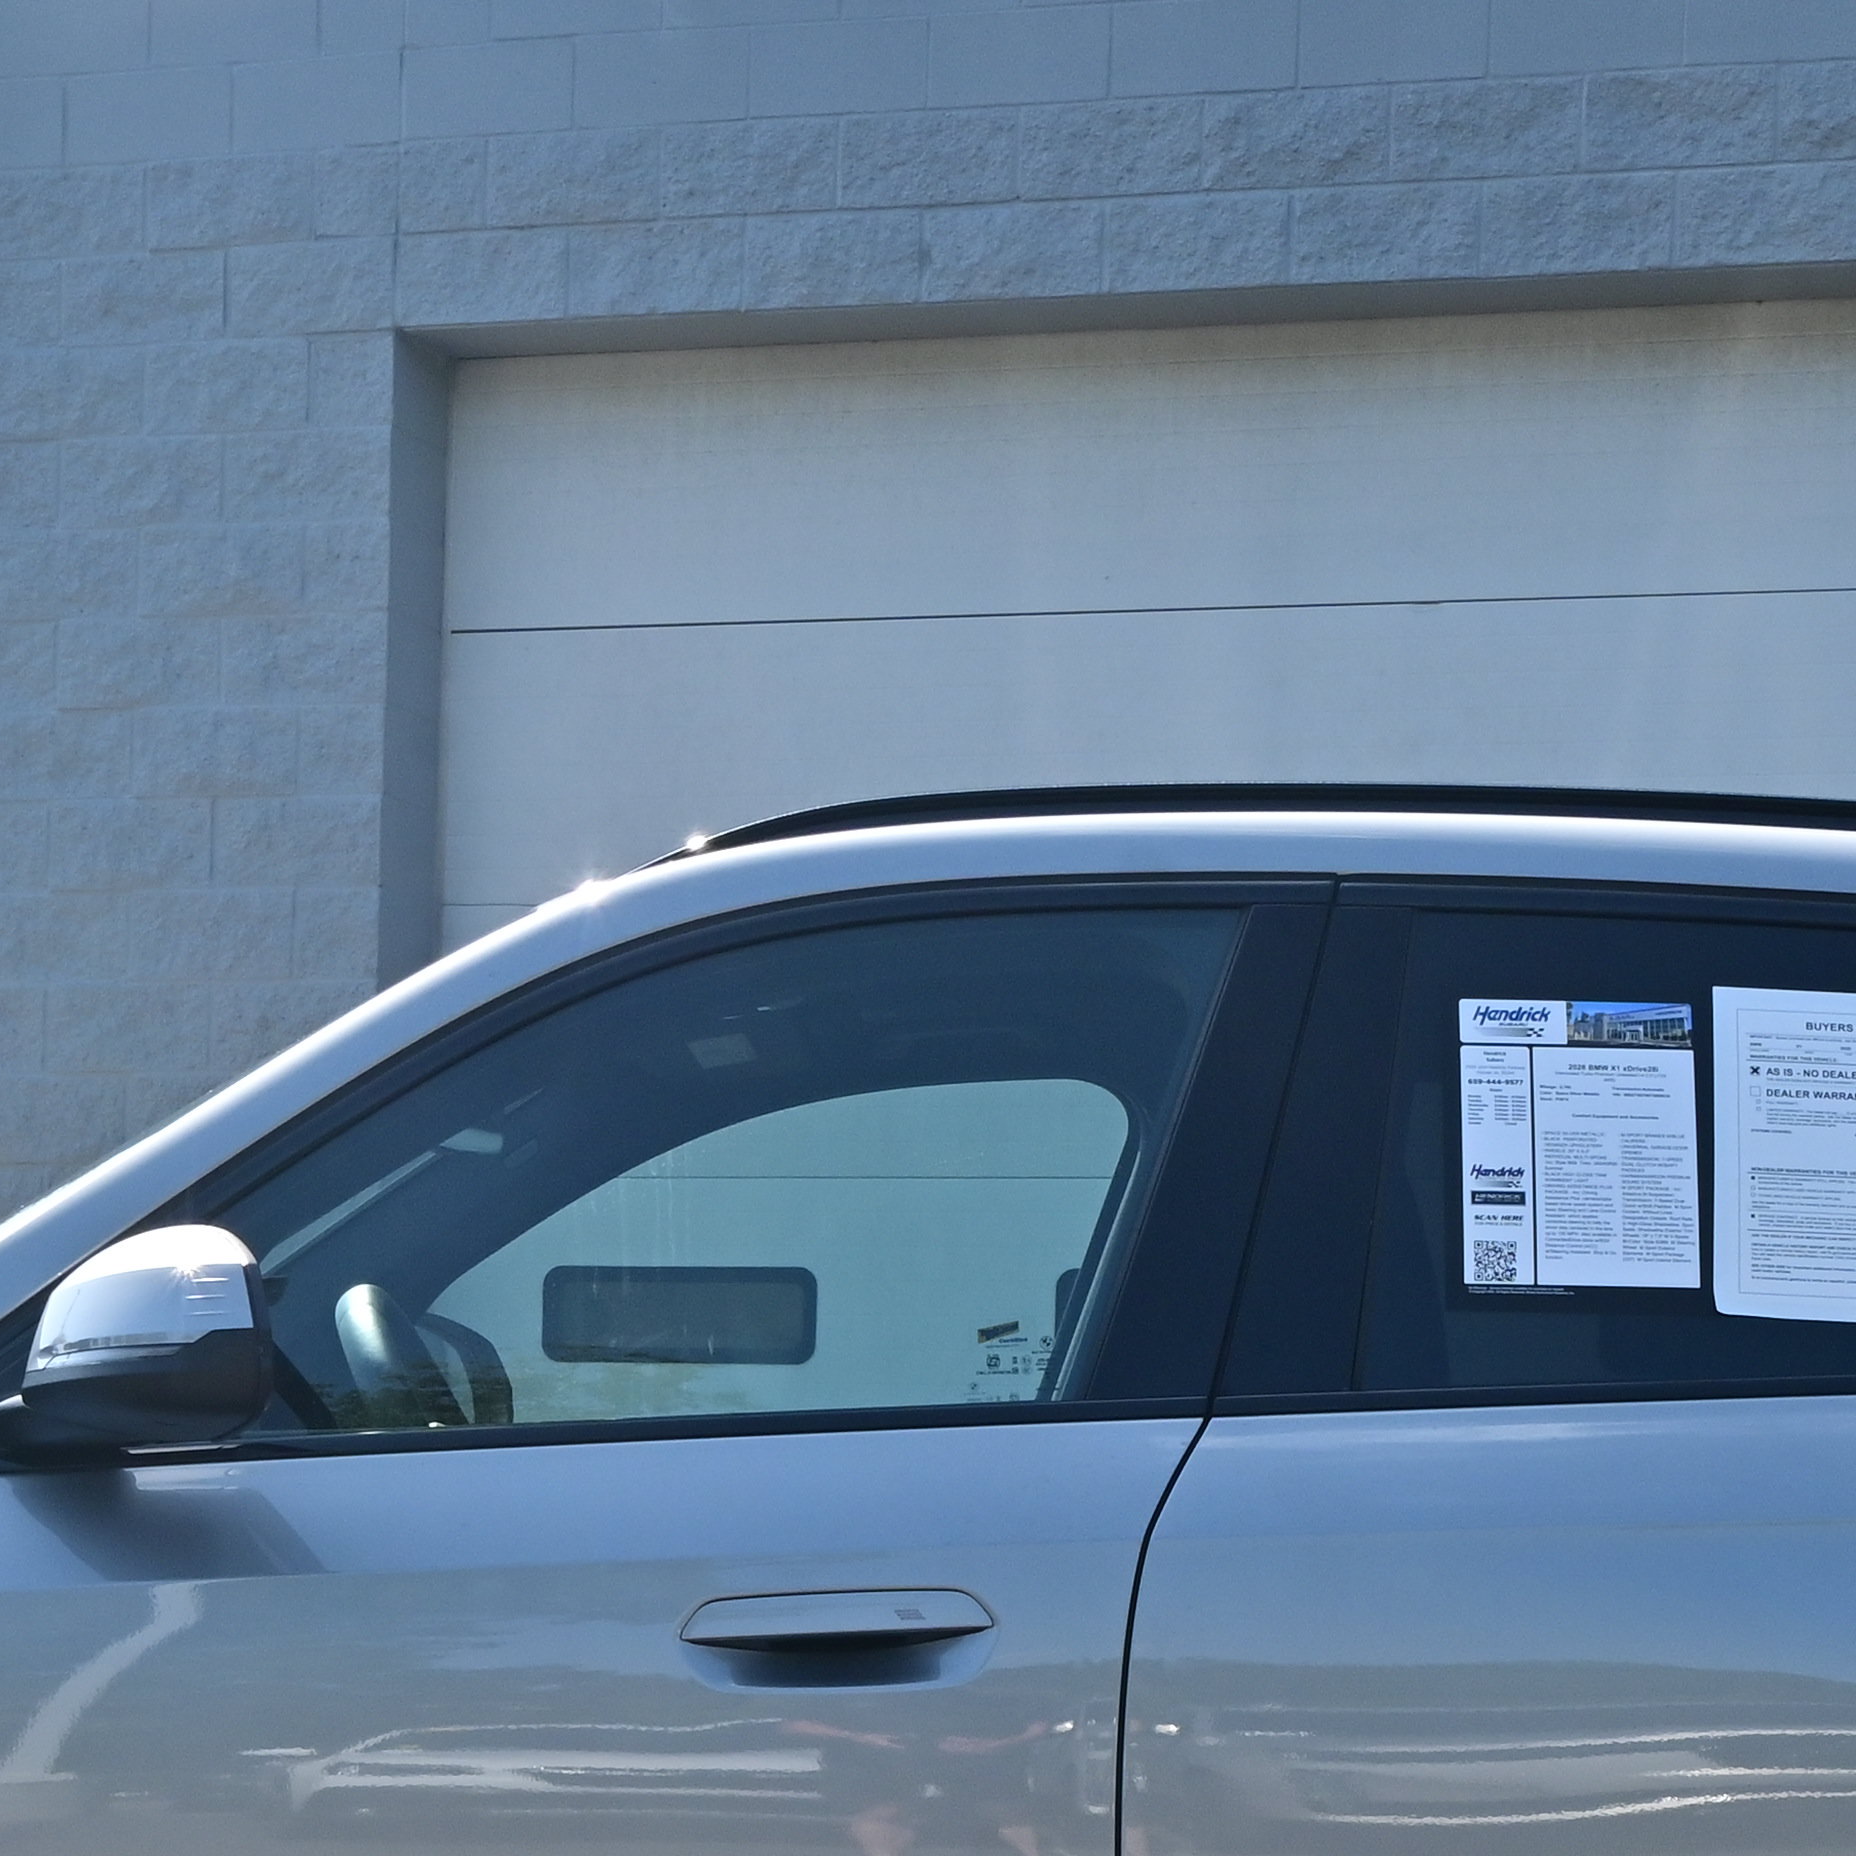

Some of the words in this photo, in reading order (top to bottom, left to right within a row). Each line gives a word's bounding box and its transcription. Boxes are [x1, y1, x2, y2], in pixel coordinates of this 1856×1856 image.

[1472, 1005, 1551, 1026] Hendrick
[1805, 1021, 1854, 1033] BUYERS
[1588, 1064, 1609, 1072] BMW
[1766, 1067, 1781, 1076] AS
[1783, 1068, 1794, 1077] IS
[1803, 1069, 1819, 1078] NO
[1766, 1088, 1810, 1099] DEALER
[1470, 1164, 1525, 1180] Hendrick
